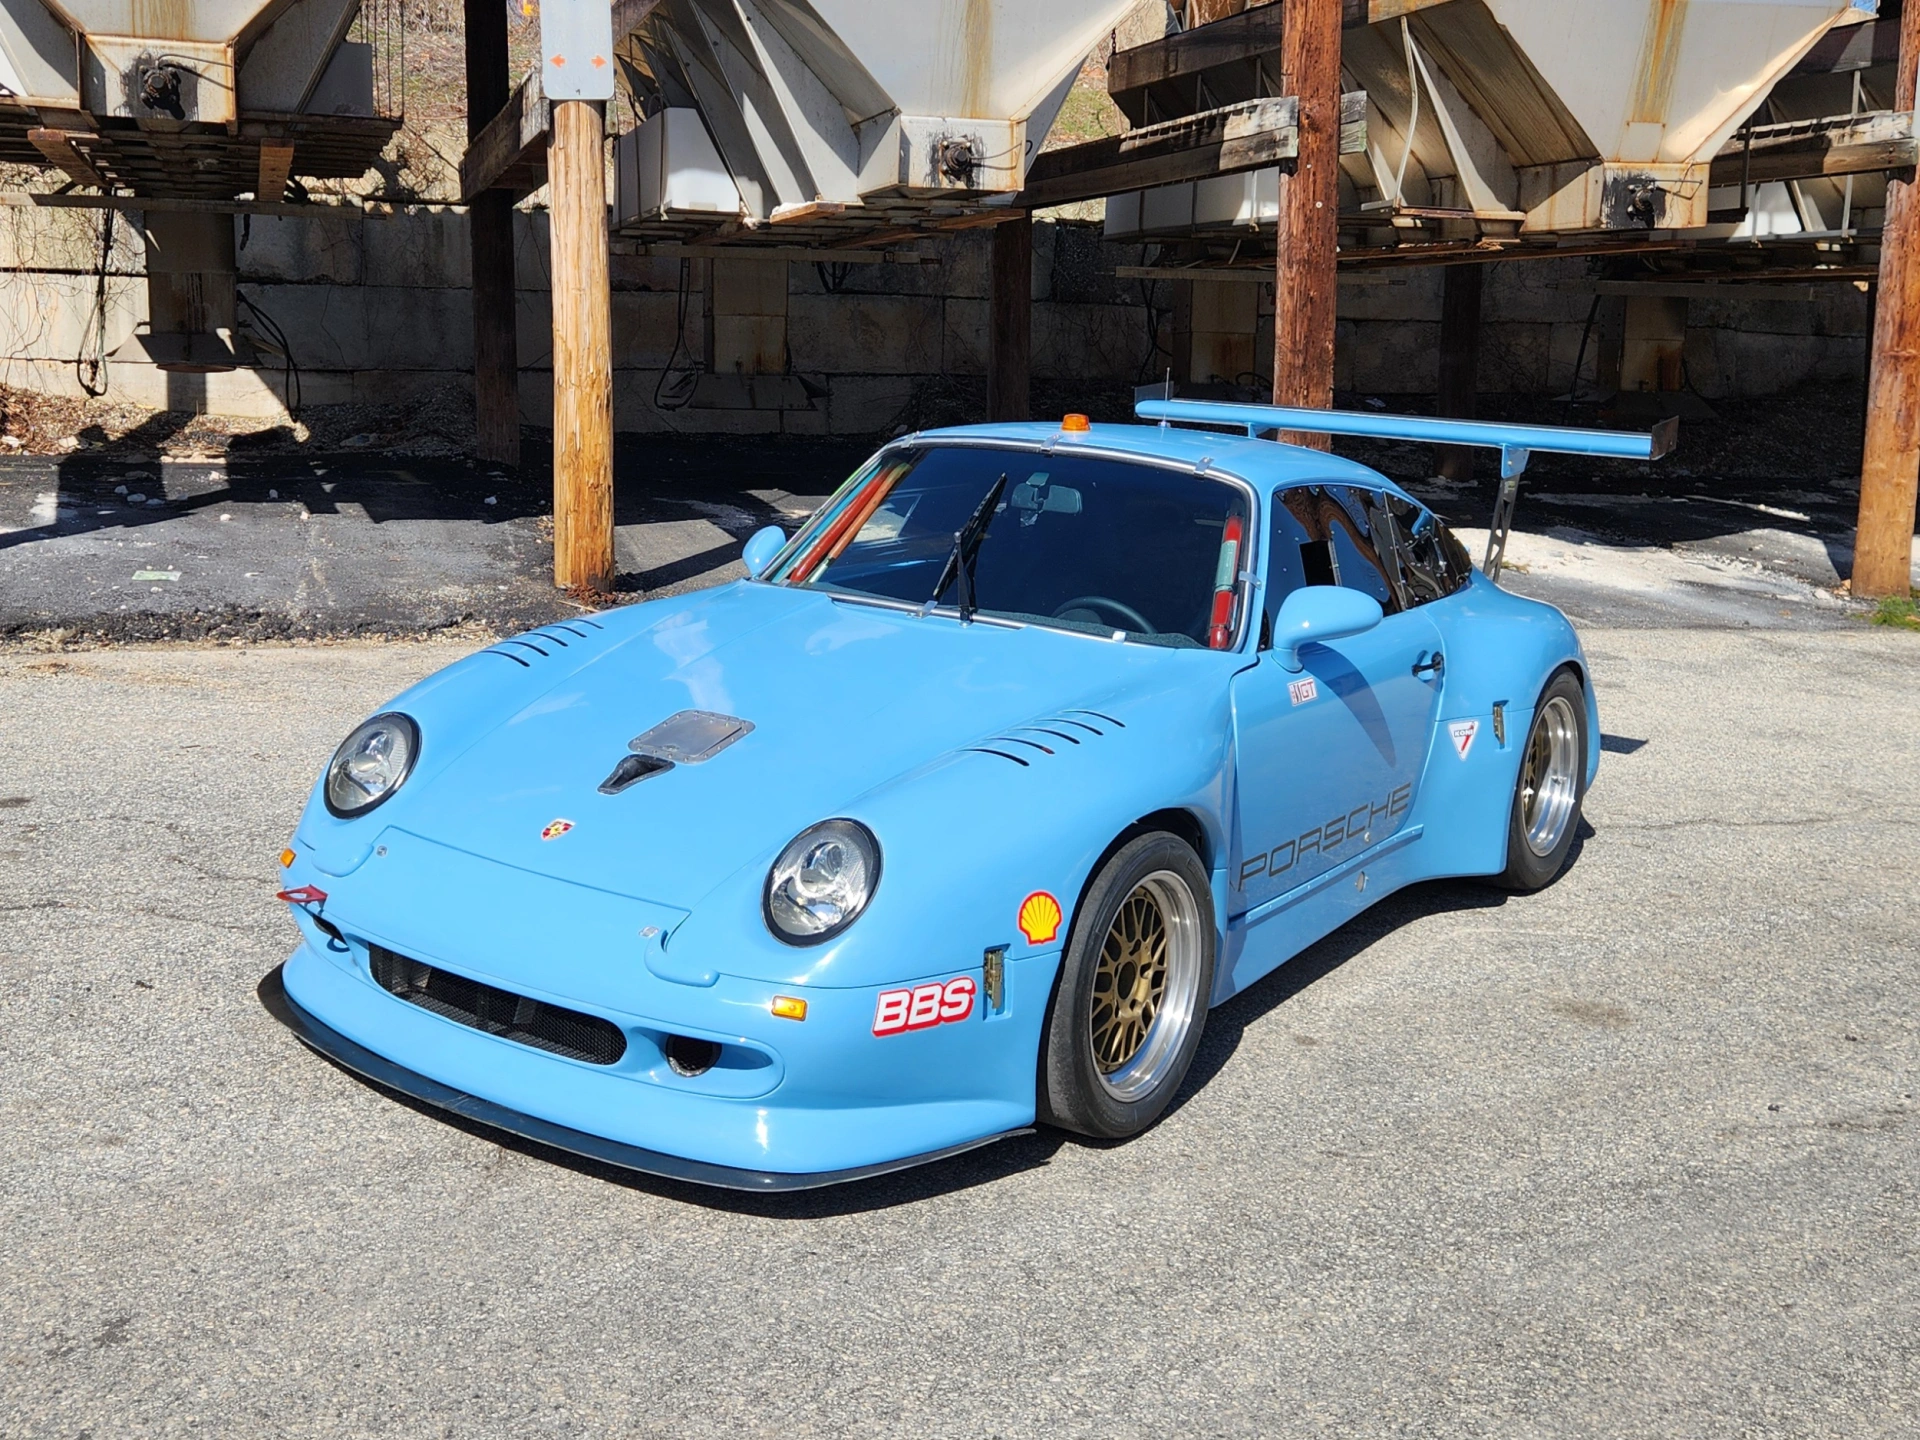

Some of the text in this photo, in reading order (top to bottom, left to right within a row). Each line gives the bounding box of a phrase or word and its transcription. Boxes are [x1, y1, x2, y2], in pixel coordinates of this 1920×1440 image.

[1454, 729, 1475, 737] KONI
[1237, 782, 1411, 892] PORSCHE
[872, 977, 976, 1036] BBS
